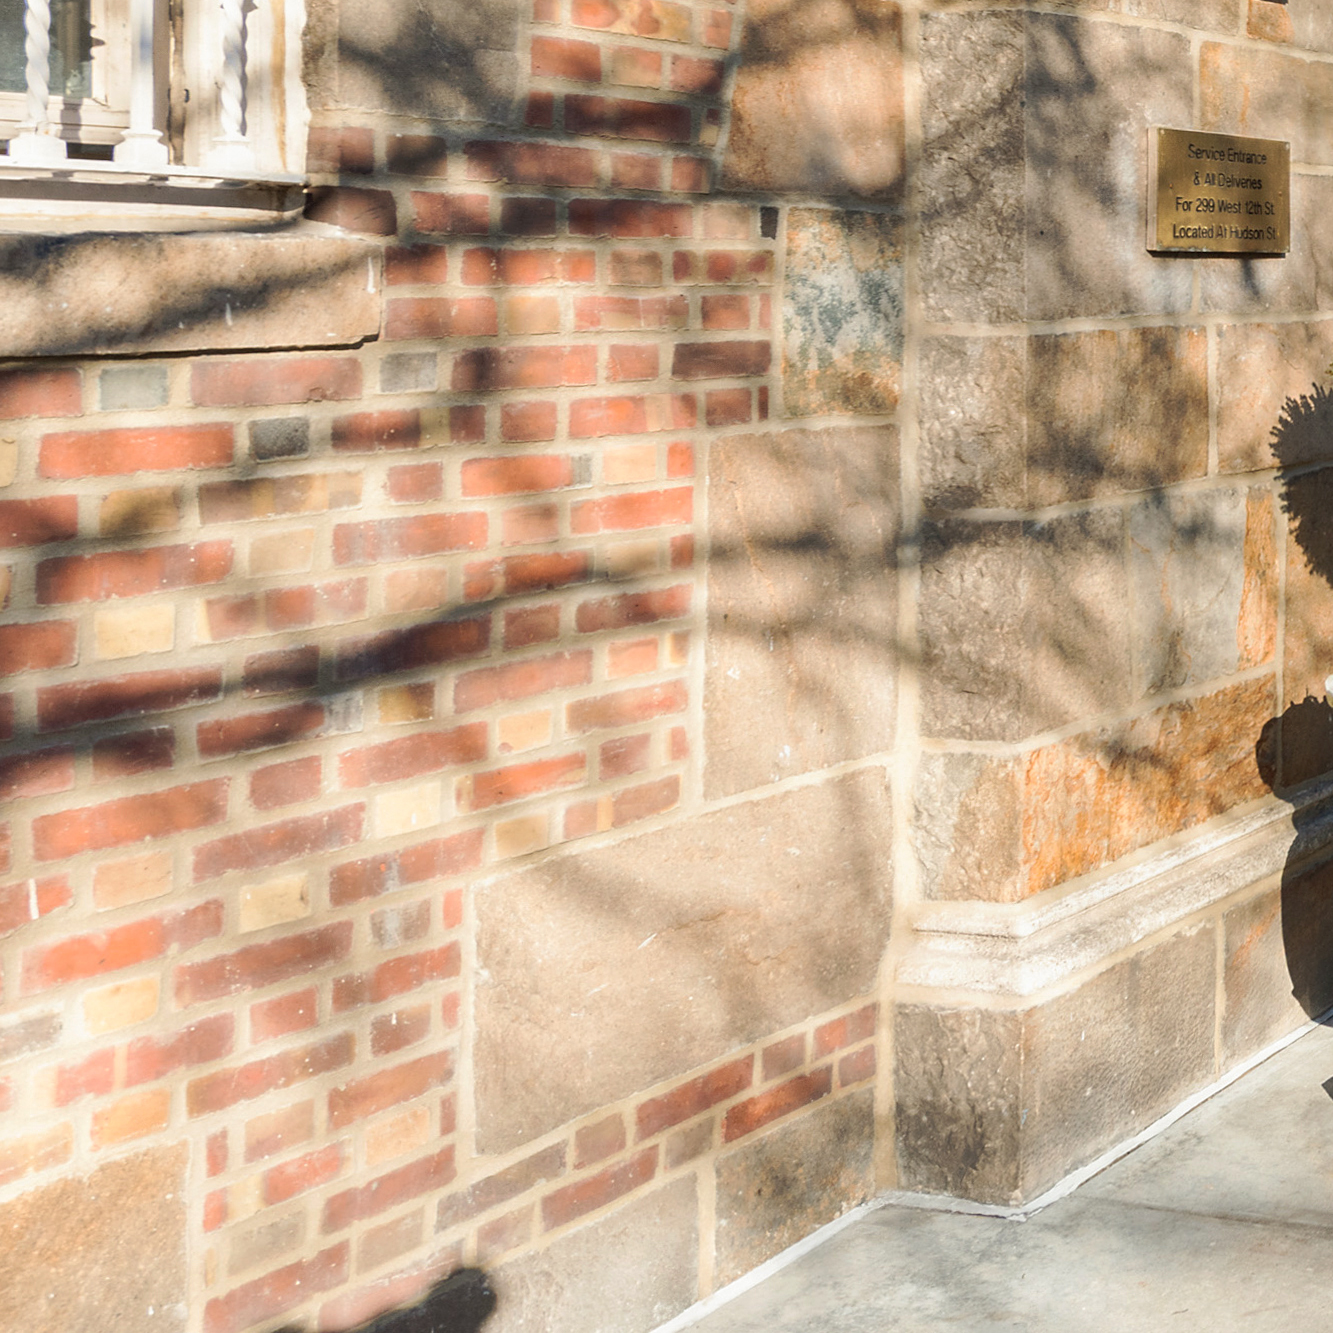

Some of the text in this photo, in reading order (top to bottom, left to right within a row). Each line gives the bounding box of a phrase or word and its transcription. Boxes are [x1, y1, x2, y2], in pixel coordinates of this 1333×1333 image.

[1188, 144, 1267, 165] Service Entrance
[1193, 171, 1262, 189] & All Deliveries
[1175, 196, 1192, 212] For
[1195, 198, 1215, 213] 299
[1217, 199, 1241, 213] West
[1245, 200, 1262, 215] 12th
[1173, 223, 1214, 239] Located
[1216, 226, 1228, 239] At
[1230, 227, 1264, 240] Hudson
